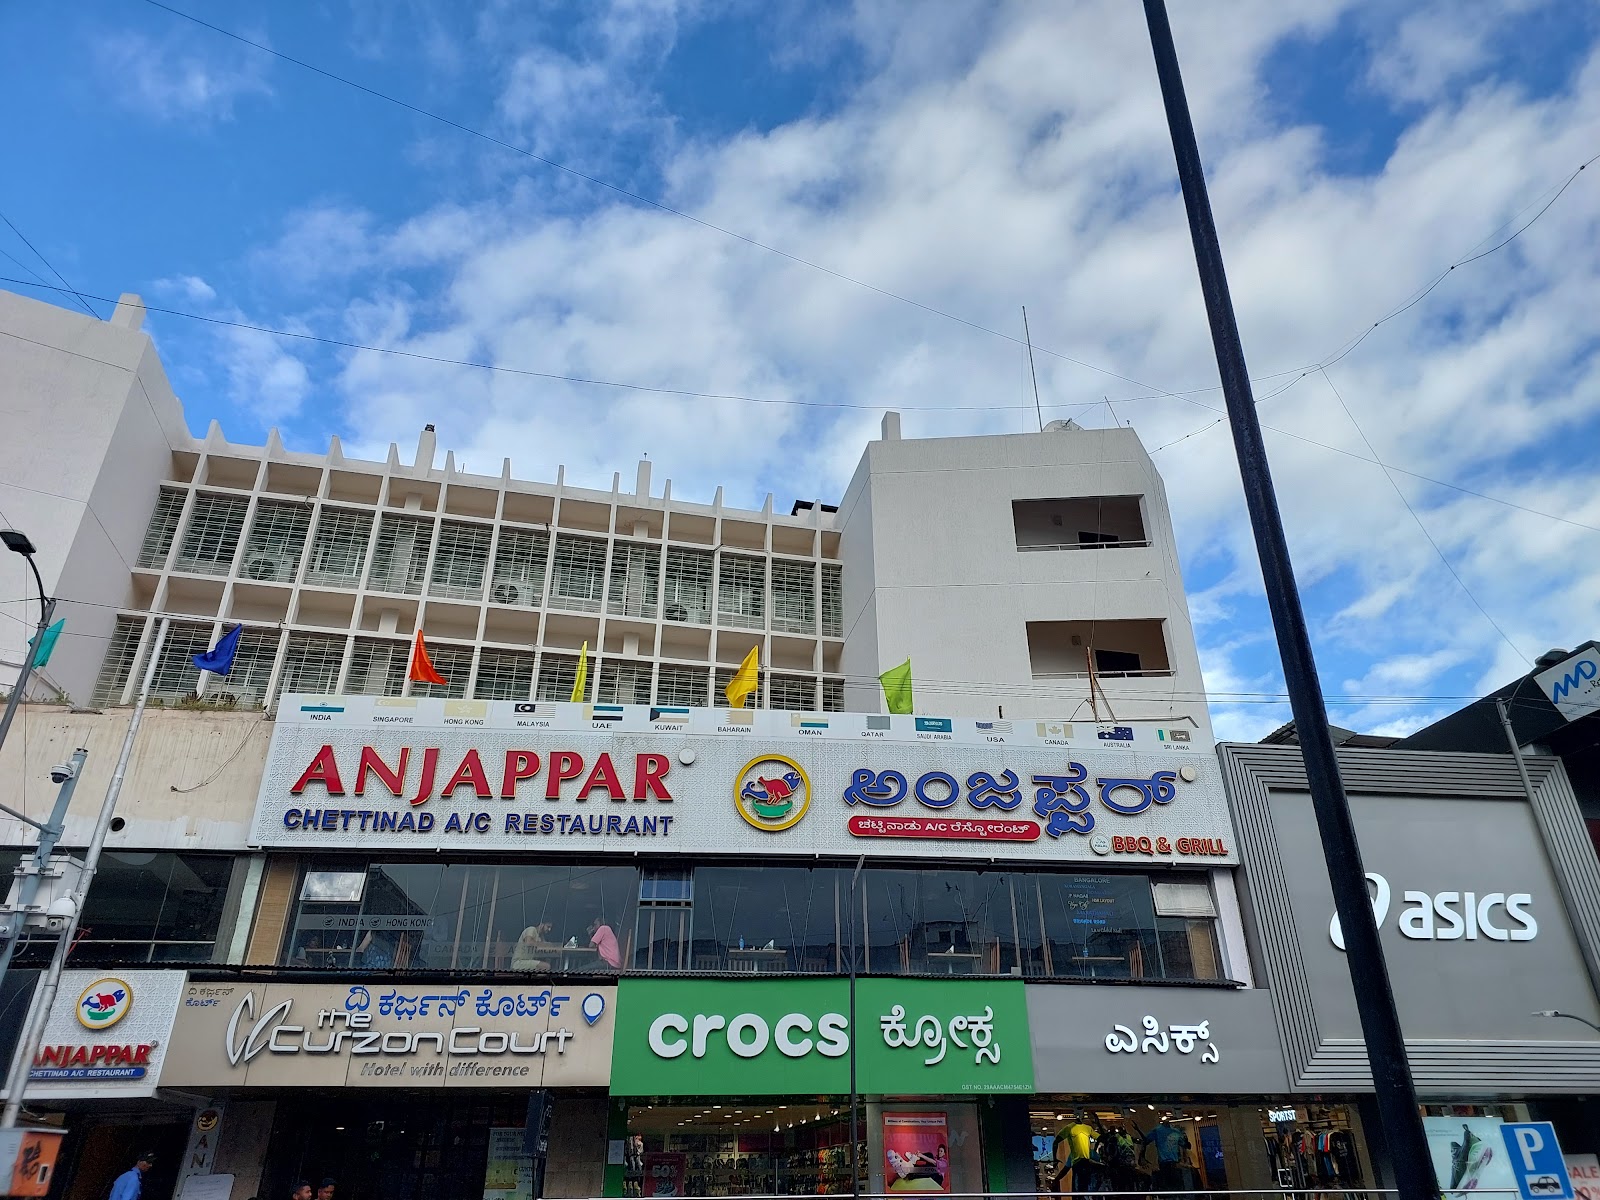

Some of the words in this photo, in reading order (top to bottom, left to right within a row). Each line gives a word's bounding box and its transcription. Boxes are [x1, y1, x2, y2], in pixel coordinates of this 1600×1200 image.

[290, 744, 674, 807] ANJAPPAR
[283, 808, 435, 833] CHETTINAD
[444, 811, 492, 834] A/C
[505, 812, 674, 836] RESTAURANT
[925, 821, 947, 831] A/C
[1113, 836, 1154, 855] BBQ
[1156, 836, 1172, 854] &
[1177, 837, 1228, 856] GRILL
[338, 918, 365, 927] INDIA
[386, 919, 408, 927] HONG
[1398, 890, 1538, 941] asics
[318, 1008, 373, 1028] the
[648, 1012, 851, 1058] crocs
[1105, 1015, 1220, 1064] ಎಸಿಕ್ಸ್
[70, 1069, 85, 1077] A/C
[86, 1068, 136, 1077] RESTAURANT
[361, 1062, 405, 1077] Hotel
[410, 1062, 444, 1078] with
[449, 1062, 530, 1077] difference
[1514, 1127, 1545, 1171] P
